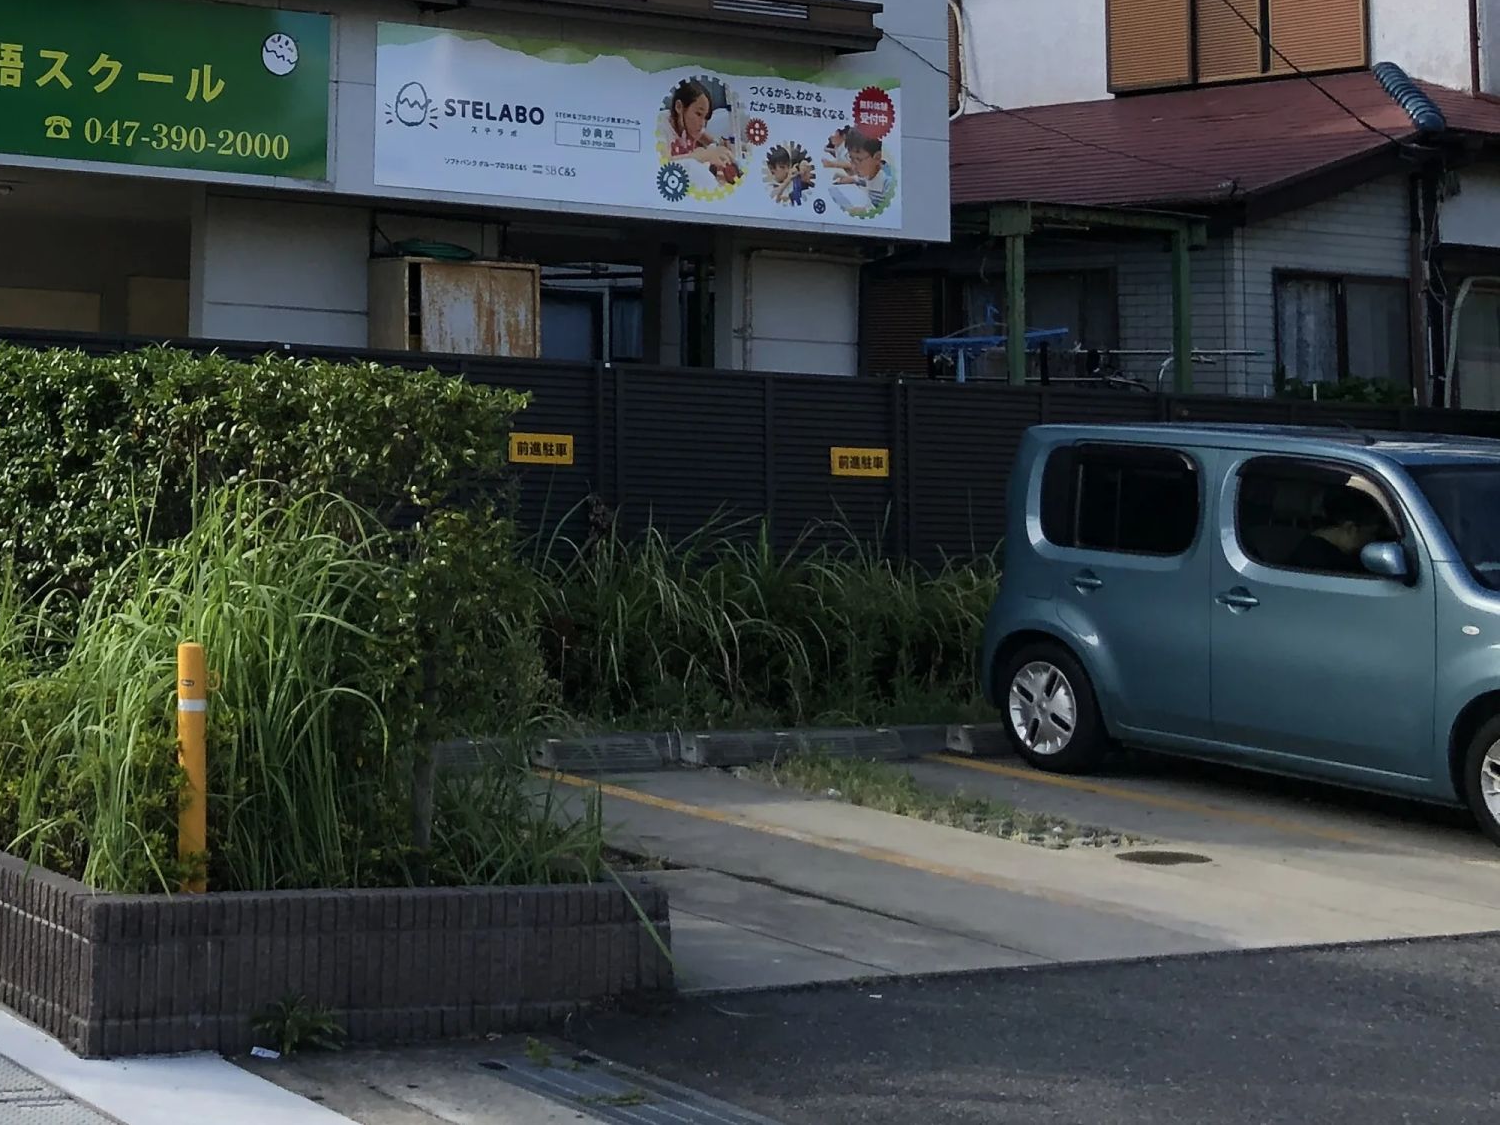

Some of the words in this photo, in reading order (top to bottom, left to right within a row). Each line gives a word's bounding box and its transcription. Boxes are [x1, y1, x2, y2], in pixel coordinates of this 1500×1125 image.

[444, 98, 545, 126] STELABO
[84, 116, 290, 162] 047-390-2000
[471, 125, 518, 138] ステラボ
